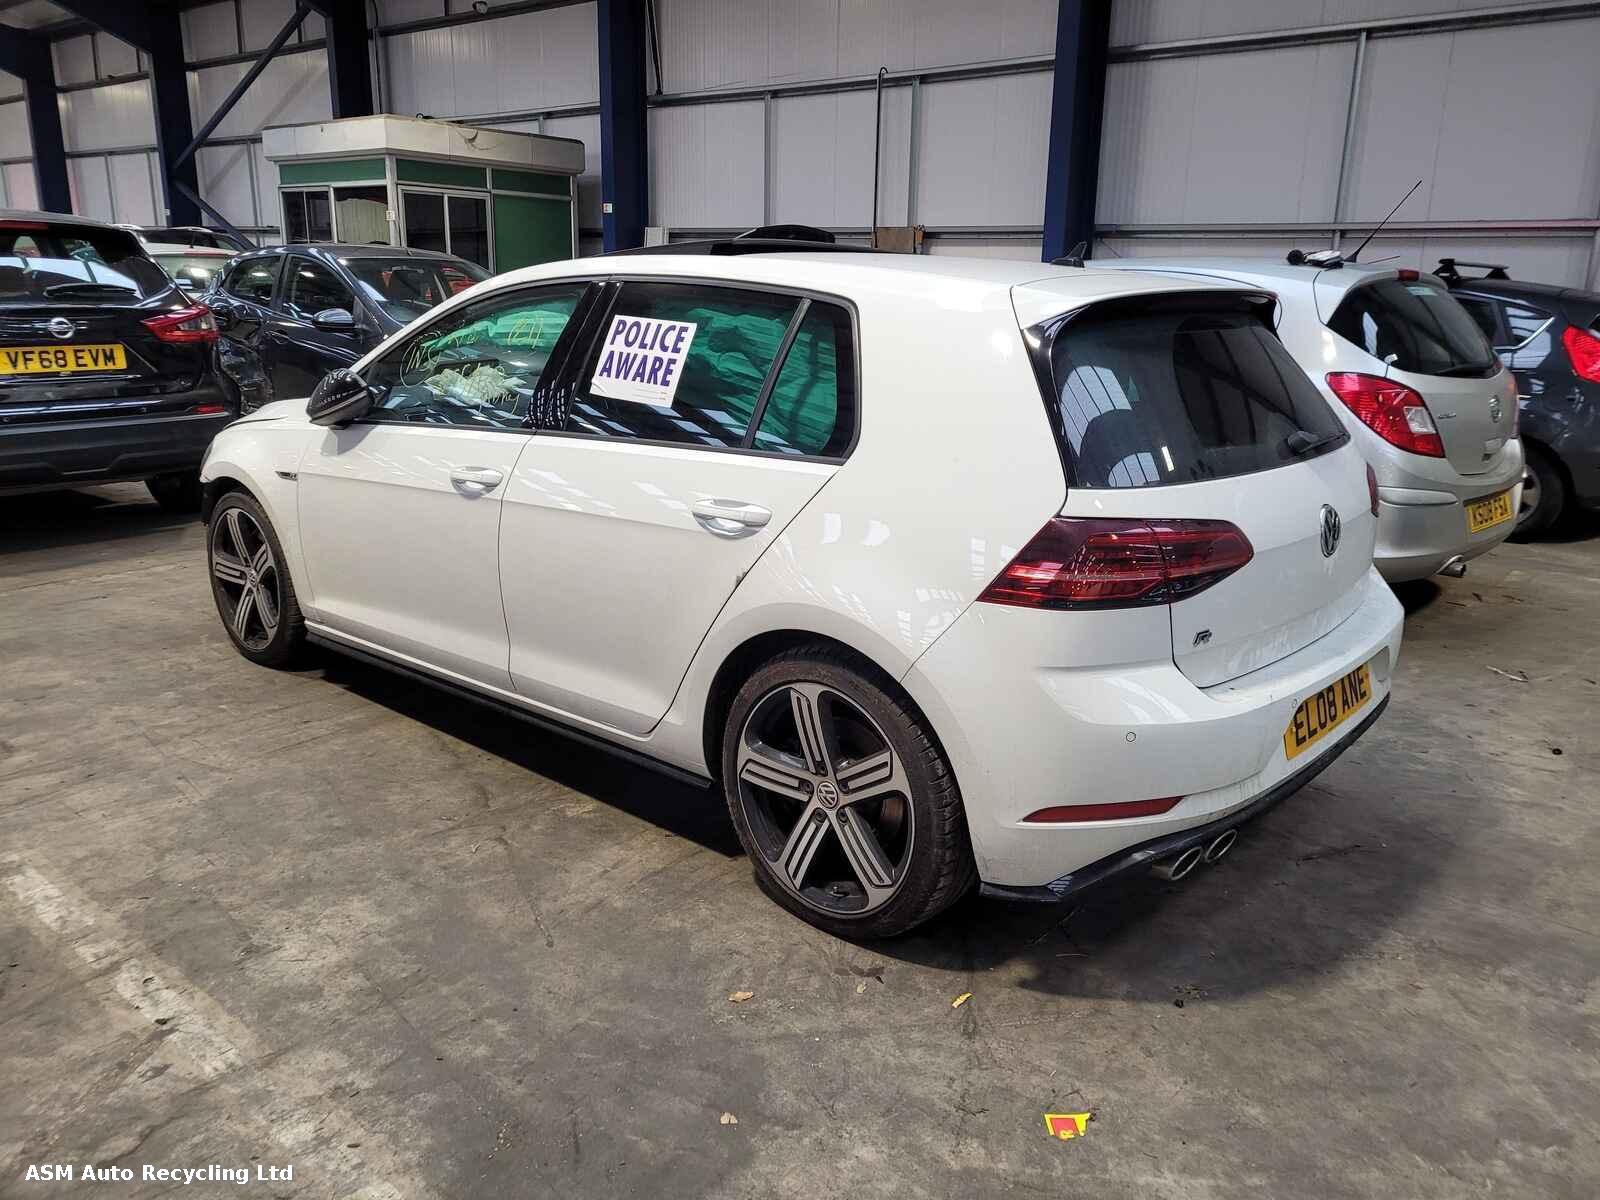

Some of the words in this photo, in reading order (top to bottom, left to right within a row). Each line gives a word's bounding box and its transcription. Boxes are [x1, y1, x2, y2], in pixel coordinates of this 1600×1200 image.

[610, 319, 688, 353] POLICE
[6, 350, 68, 370] VF68
[73, 348, 116, 368] EVM
[599, 350, 677, 387] AWARE
[1293, 685, 1338, 747] EL08
[1341, 664, 1367, 714] ANE
